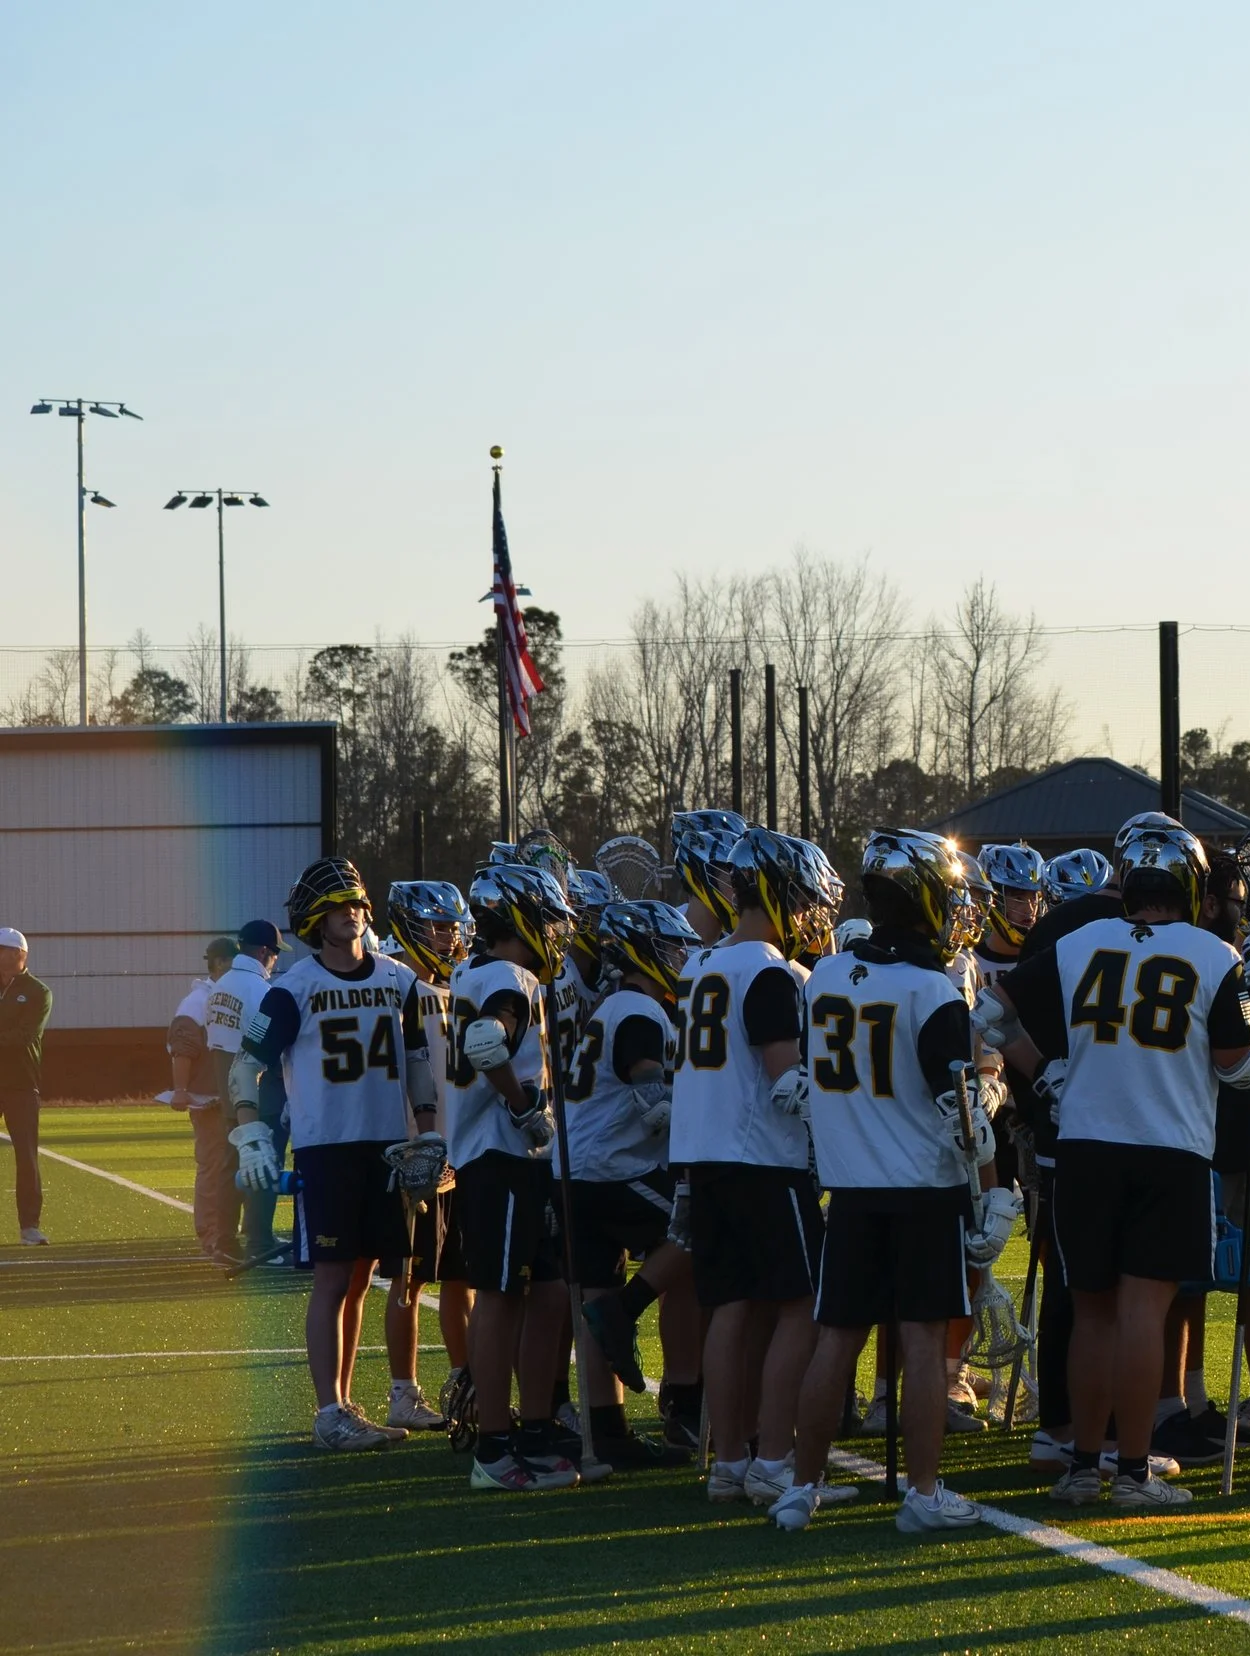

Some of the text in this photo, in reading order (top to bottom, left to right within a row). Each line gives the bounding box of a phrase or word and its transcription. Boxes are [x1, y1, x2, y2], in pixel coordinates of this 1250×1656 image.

[309, 986, 402, 1015] WILDCATS
[1070, 949, 1199, 1053] 48
[318, 1014, 400, 1084] 54
[811, 993, 899, 1100] 31
